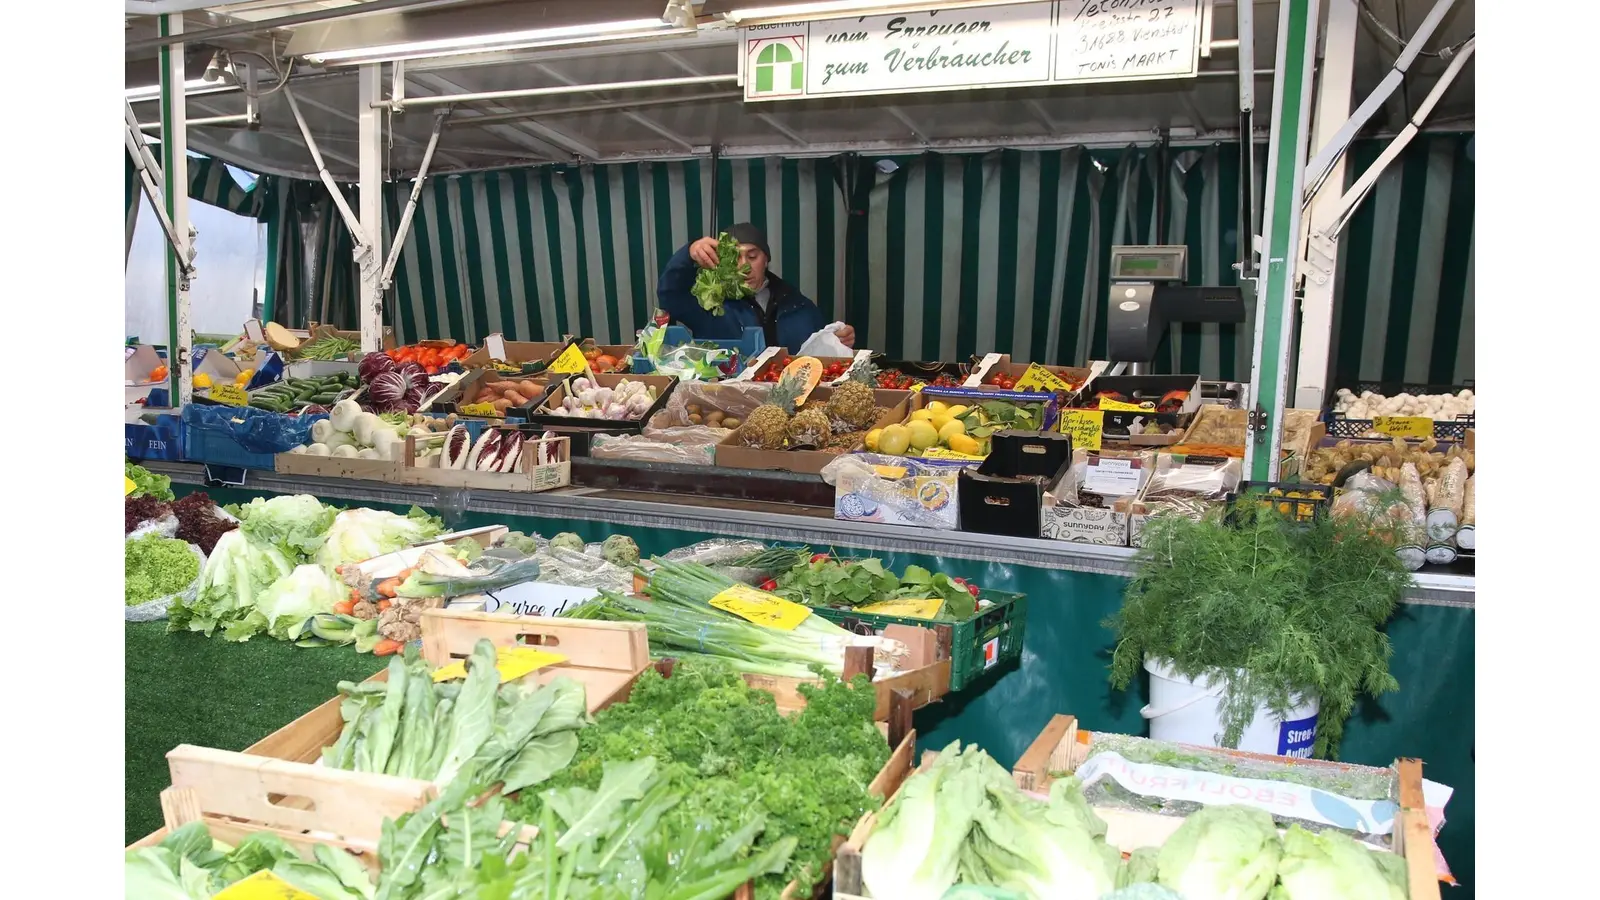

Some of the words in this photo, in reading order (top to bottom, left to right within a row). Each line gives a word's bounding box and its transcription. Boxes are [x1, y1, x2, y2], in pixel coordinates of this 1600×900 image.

[822, 61, 869, 85] zum
[884, 40, 1032, 73] Verbraucher
[1122, 49, 1178, 70] MARKT
[149, 440, 167, 450] FEIN
[484, 591, 547, 616] Surce
